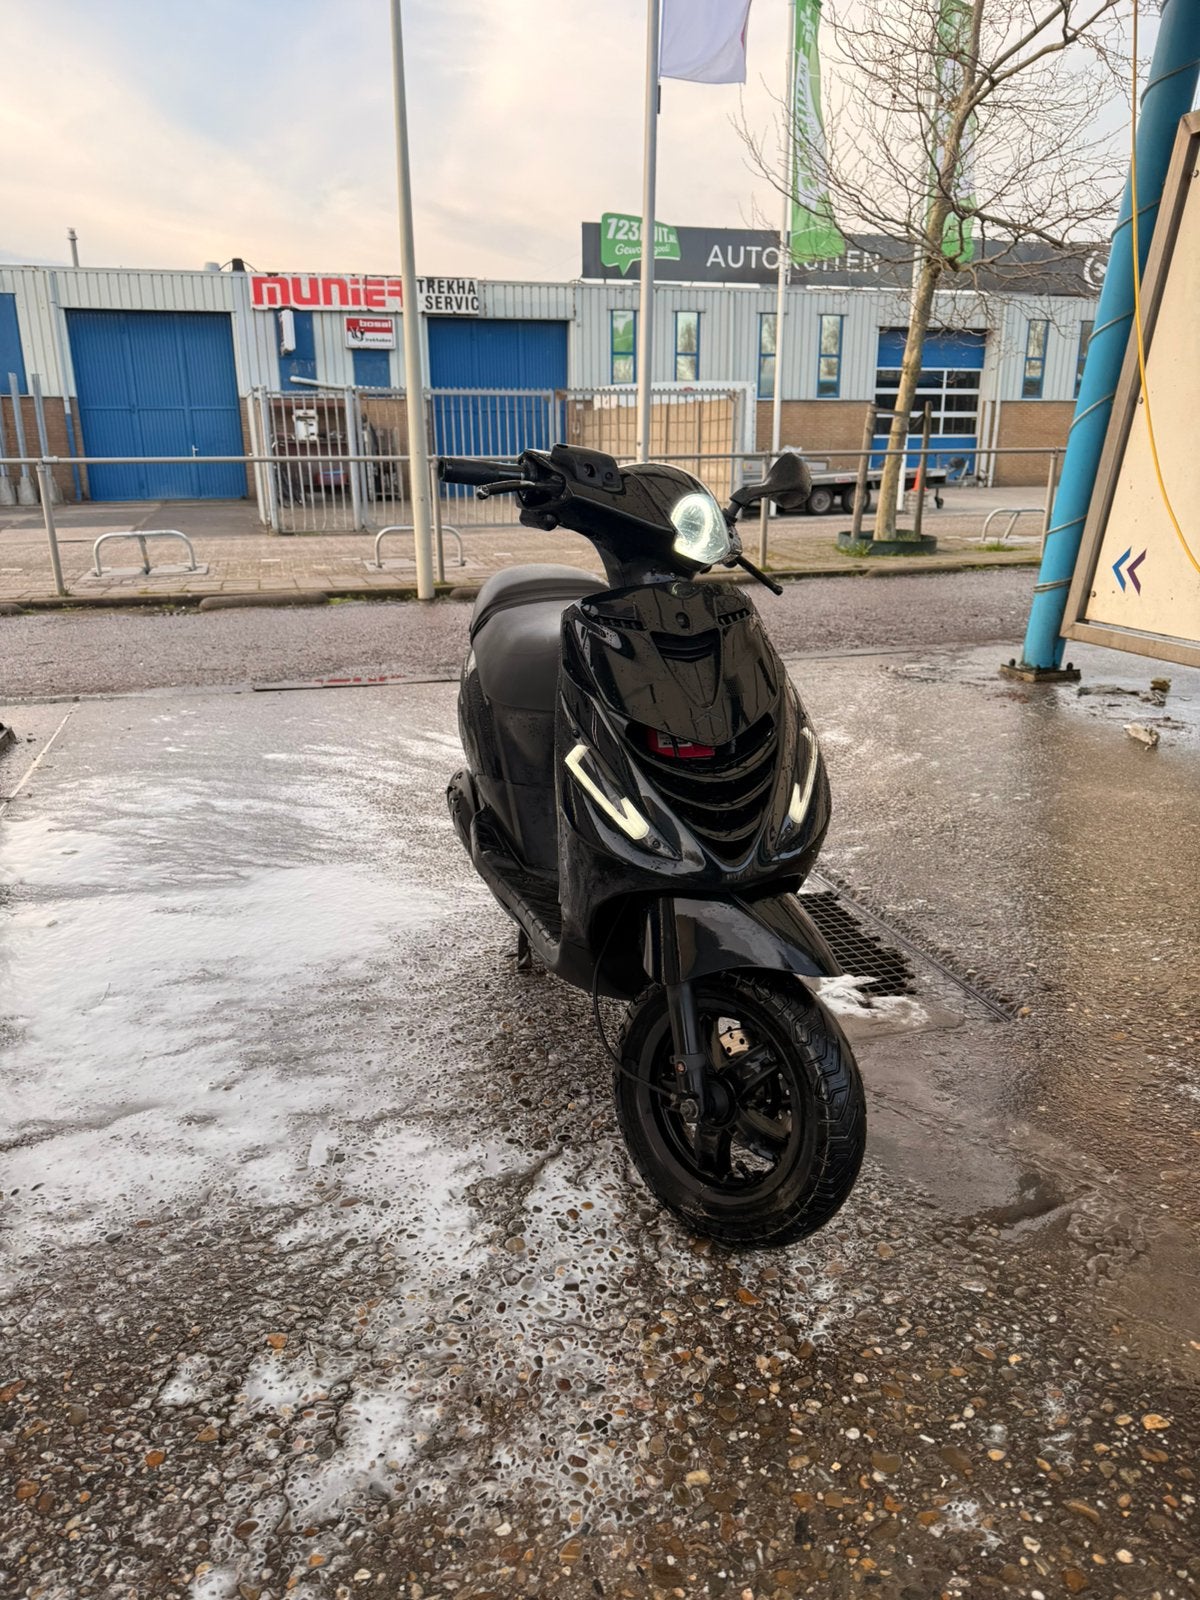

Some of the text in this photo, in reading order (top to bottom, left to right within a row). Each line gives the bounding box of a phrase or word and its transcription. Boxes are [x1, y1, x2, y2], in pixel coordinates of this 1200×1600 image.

[706, 244, 880, 273] AUTOEN
[416, 279, 476, 295] TREKHA
[425, 295, 479, 311] SERVIC
[359, 319, 392, 328] bosal
